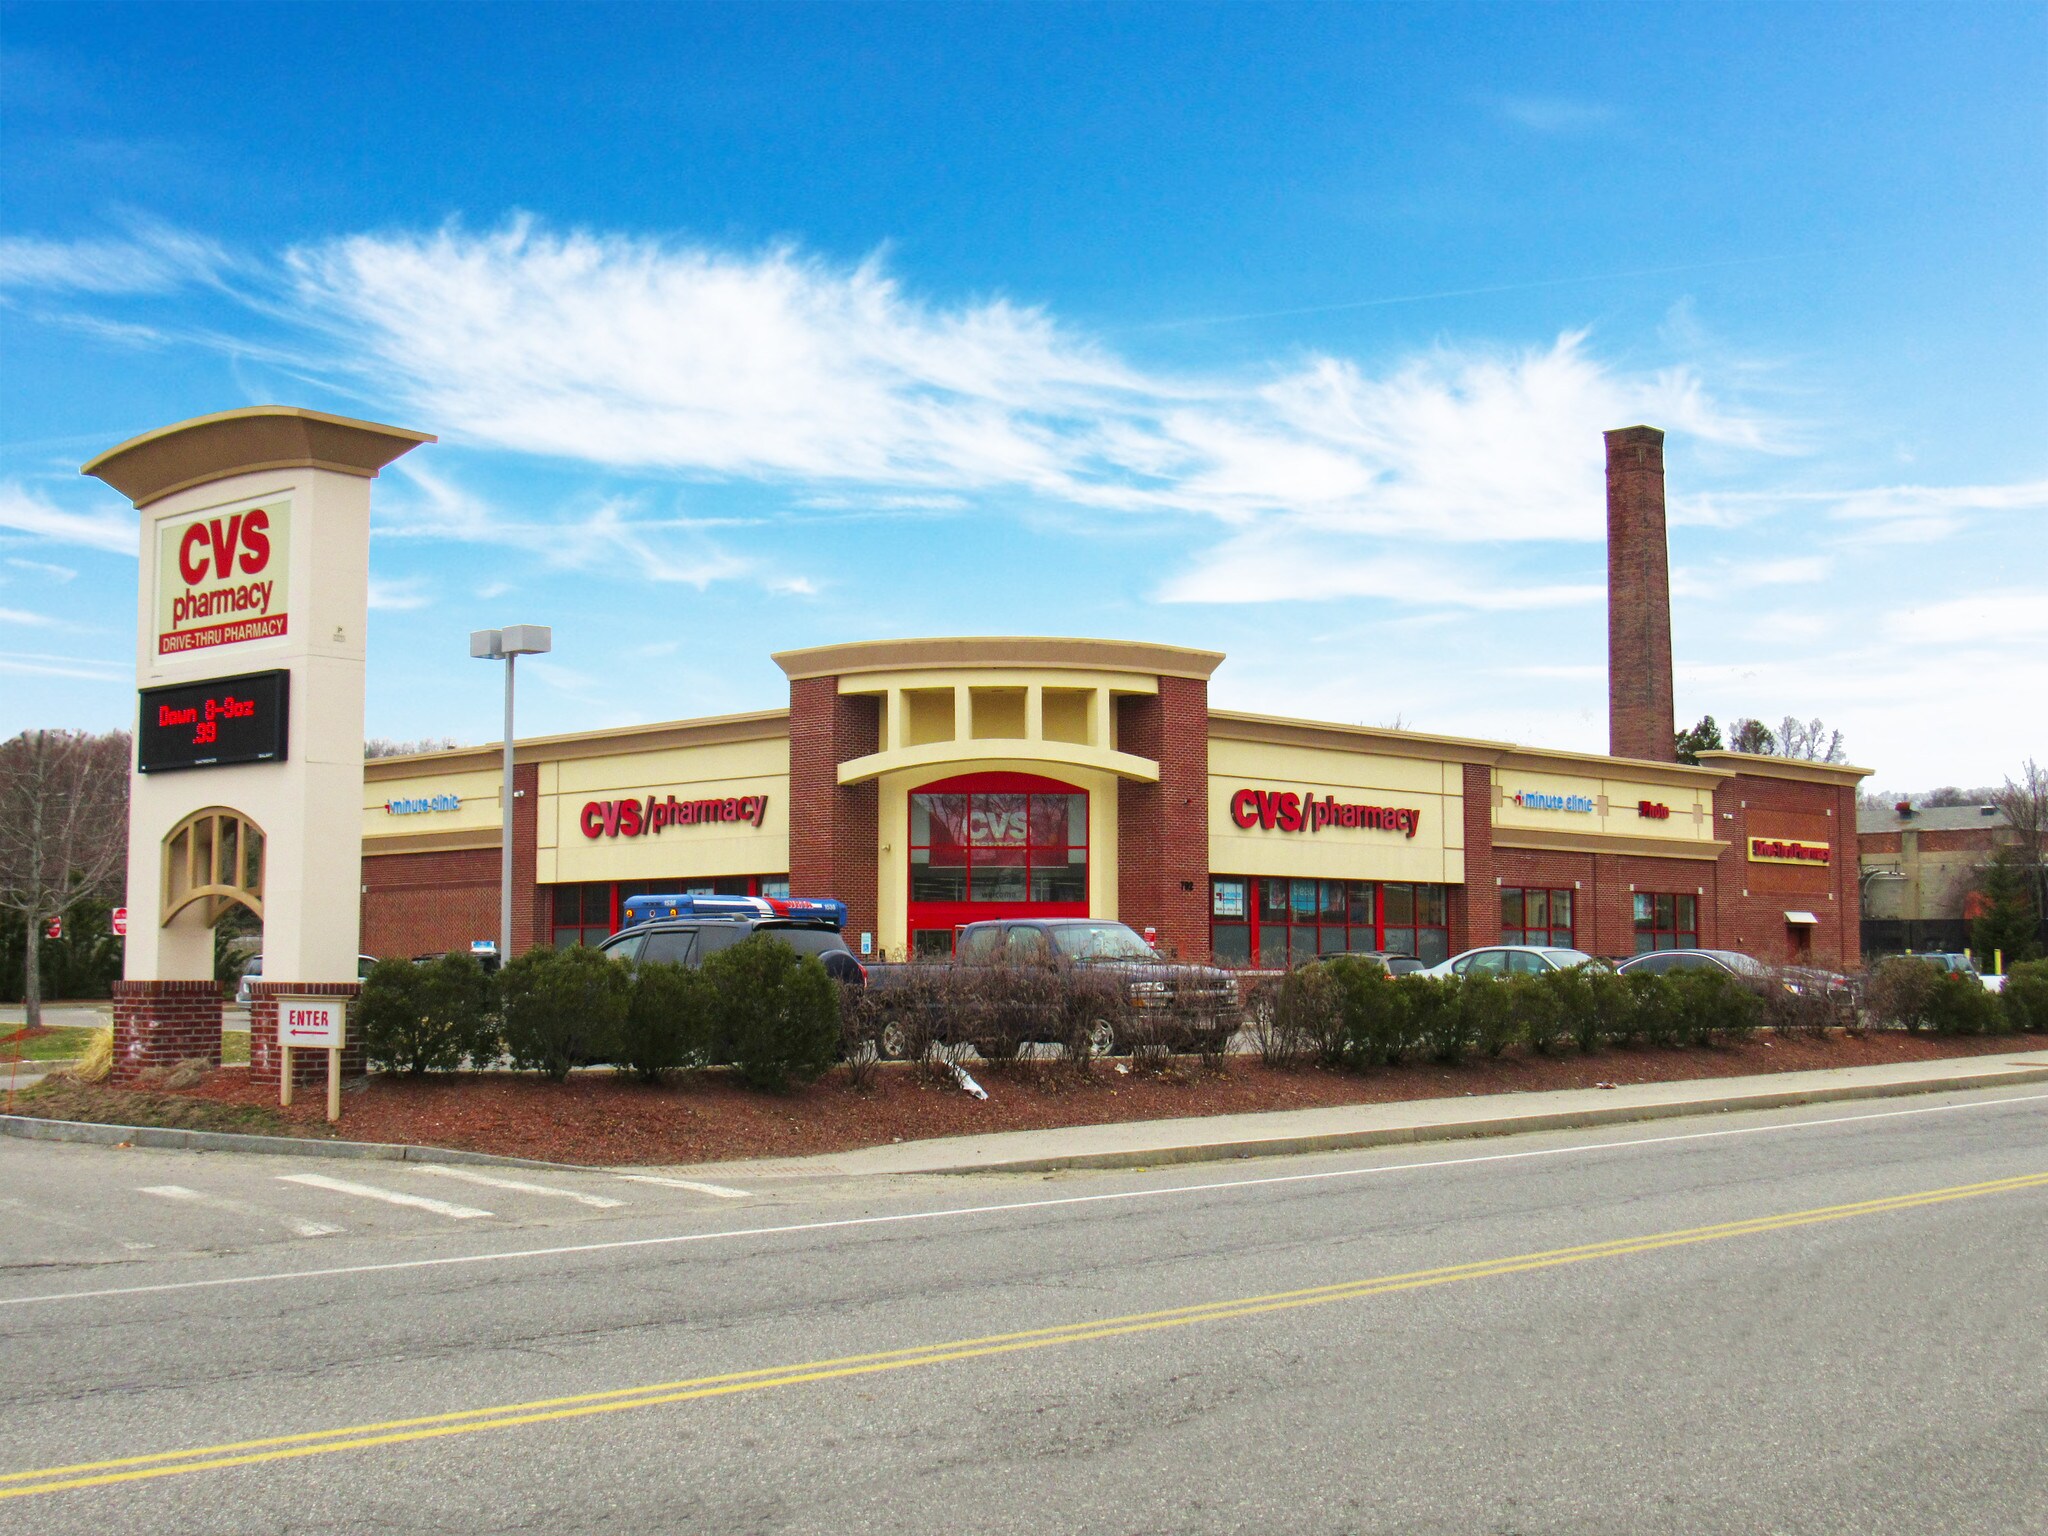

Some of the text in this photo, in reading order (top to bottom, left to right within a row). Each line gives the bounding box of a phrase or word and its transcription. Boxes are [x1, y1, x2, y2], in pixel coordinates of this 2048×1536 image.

[179, 509, 270, 586] CVS
[173, 580, 273, 630] pharmacy
[162, 618, 284, 653] DRIVE-THRU PHARMACY
[391, 794, 459, 815] minute clinic
[1525, 790, 1593, 813] minute clinic
[962, 811, 1032, 839] CVS
[289, 1010, 329, 1026] ENTER
